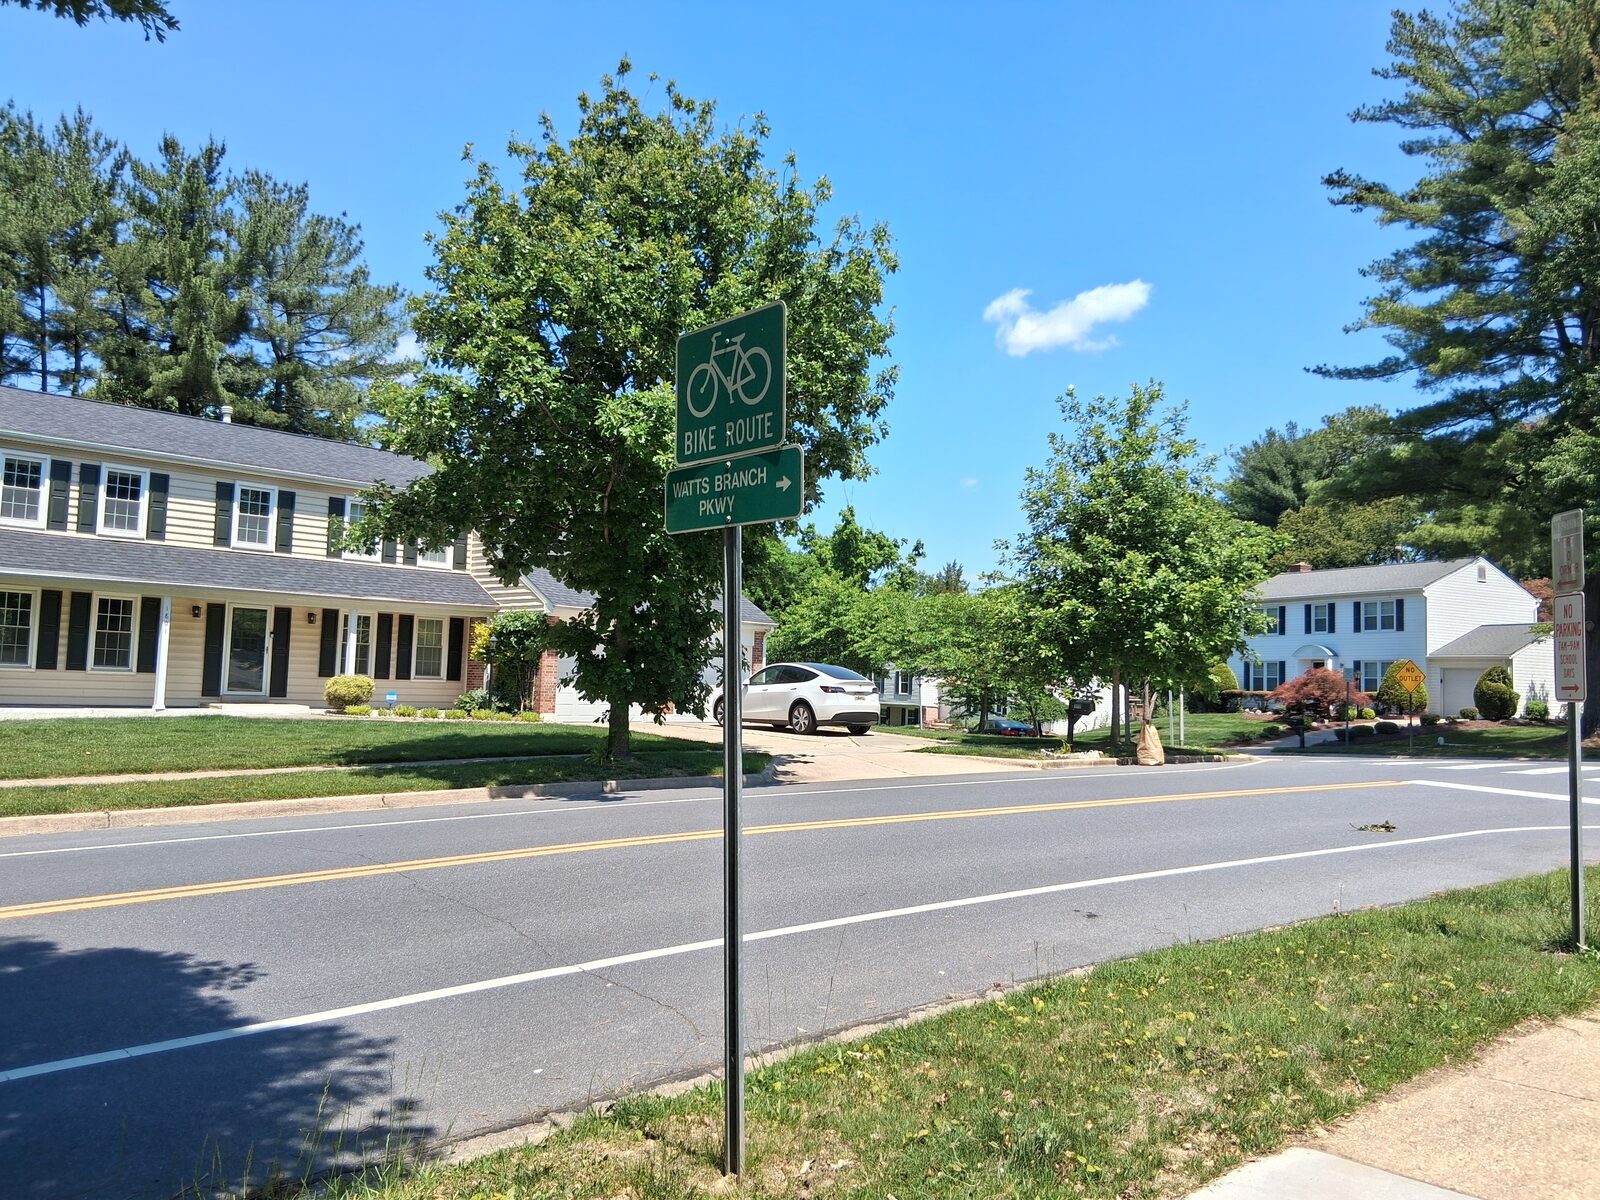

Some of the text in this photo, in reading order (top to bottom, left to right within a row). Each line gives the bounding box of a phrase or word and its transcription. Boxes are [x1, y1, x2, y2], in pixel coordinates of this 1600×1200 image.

[684, 412, 774, 455] BIKE ROUTE
[672, 466, 767, 498] WATTS BRANCH
[699, 495, 735, 516] PKWY
[1563, 603, 1573, 619] NO
[1555, 621, 1582, 638] PARKING
[1560, 653, 1578, 665] SCHOOL
[1563, 667, 1575, 678] DAYS
